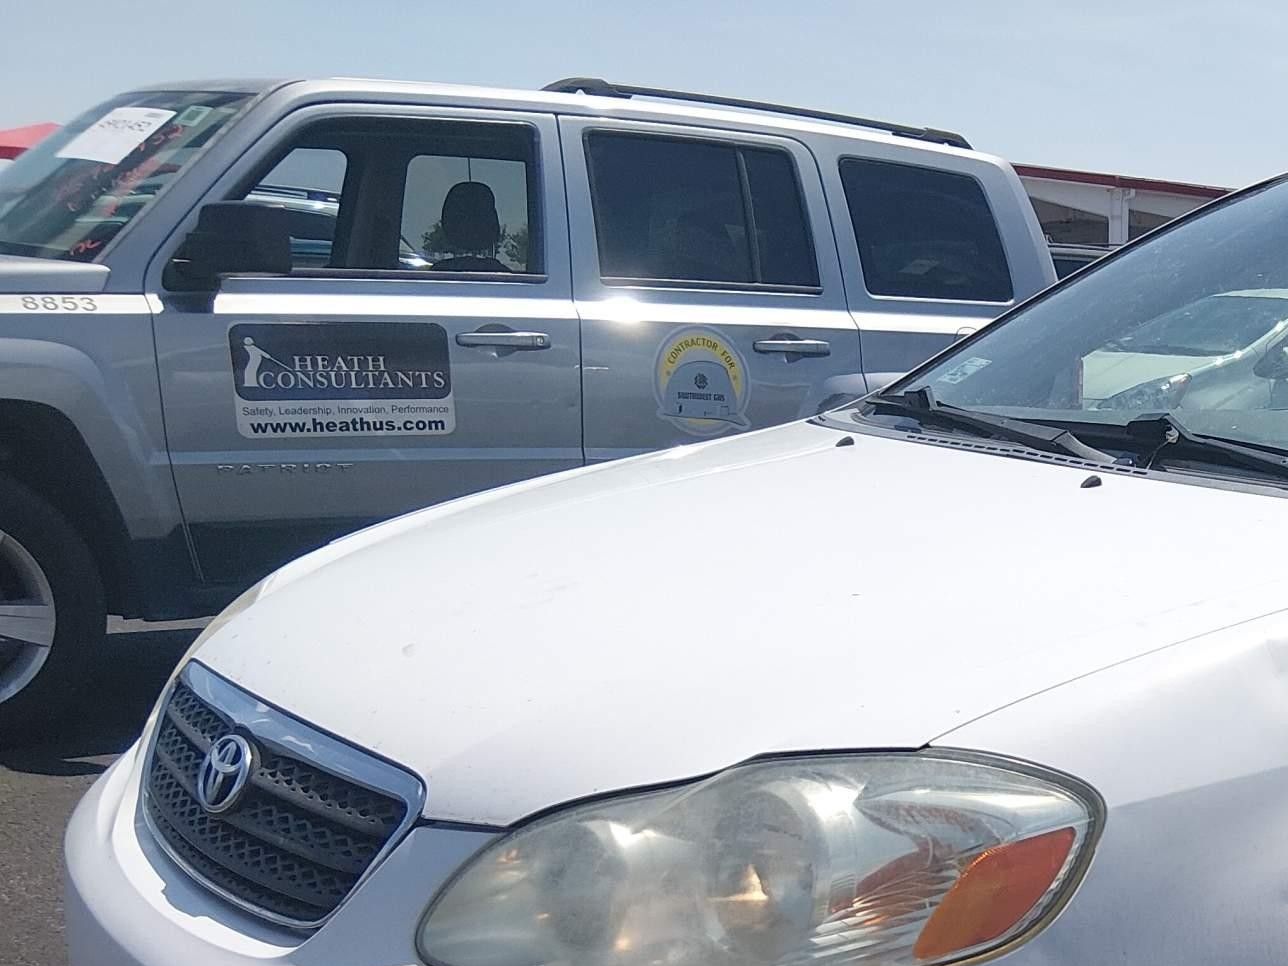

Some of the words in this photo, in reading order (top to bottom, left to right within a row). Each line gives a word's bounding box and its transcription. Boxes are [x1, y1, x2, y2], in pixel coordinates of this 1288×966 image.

[20, 295, 99, 312] 8853
[667, 338, 718, 364] CONTRACTOR
[720, 350, 735, 369] FOR
[293, 355, 387, 371] HEATH
[258, 371, 446, 389] CONSULTANTS
[242, 406, 277, 418] Safety,
[278, 405, 335, 417] Leadership,
[391, 404, 449, 414] Performance
[249, 418, 446, 434] www.heathus.com
